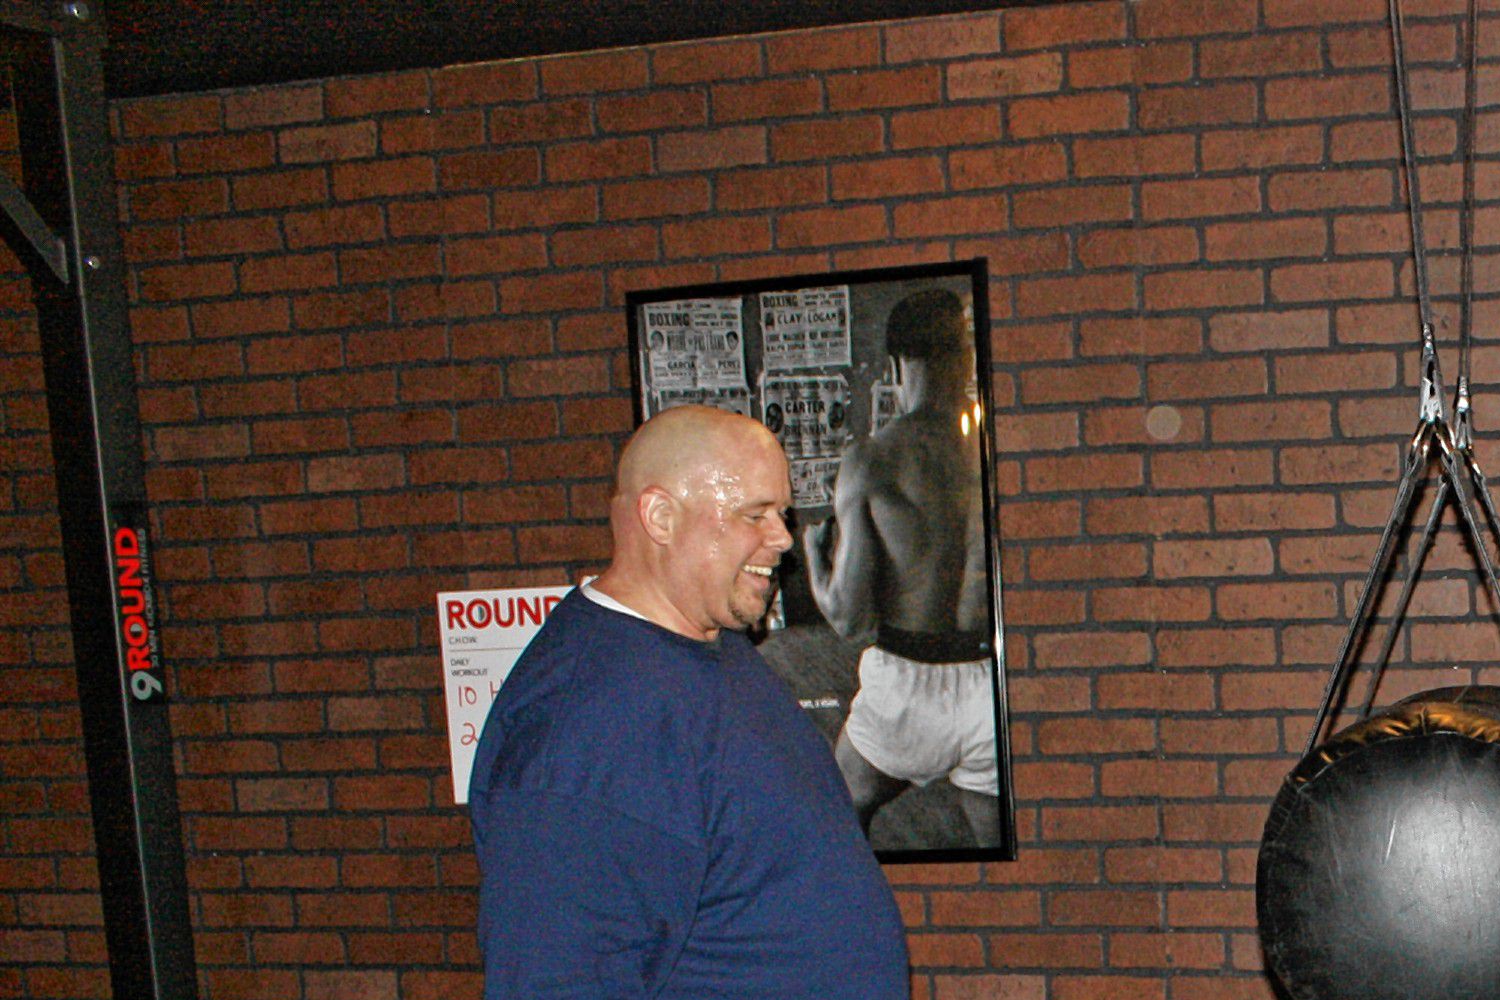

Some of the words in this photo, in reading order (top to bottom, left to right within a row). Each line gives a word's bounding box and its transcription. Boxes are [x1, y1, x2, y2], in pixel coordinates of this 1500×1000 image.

[648, 313, 690, 327] BOXING
[777, 313, 802, 324] CLAY
[785, 400, 826, 414] CARTER
